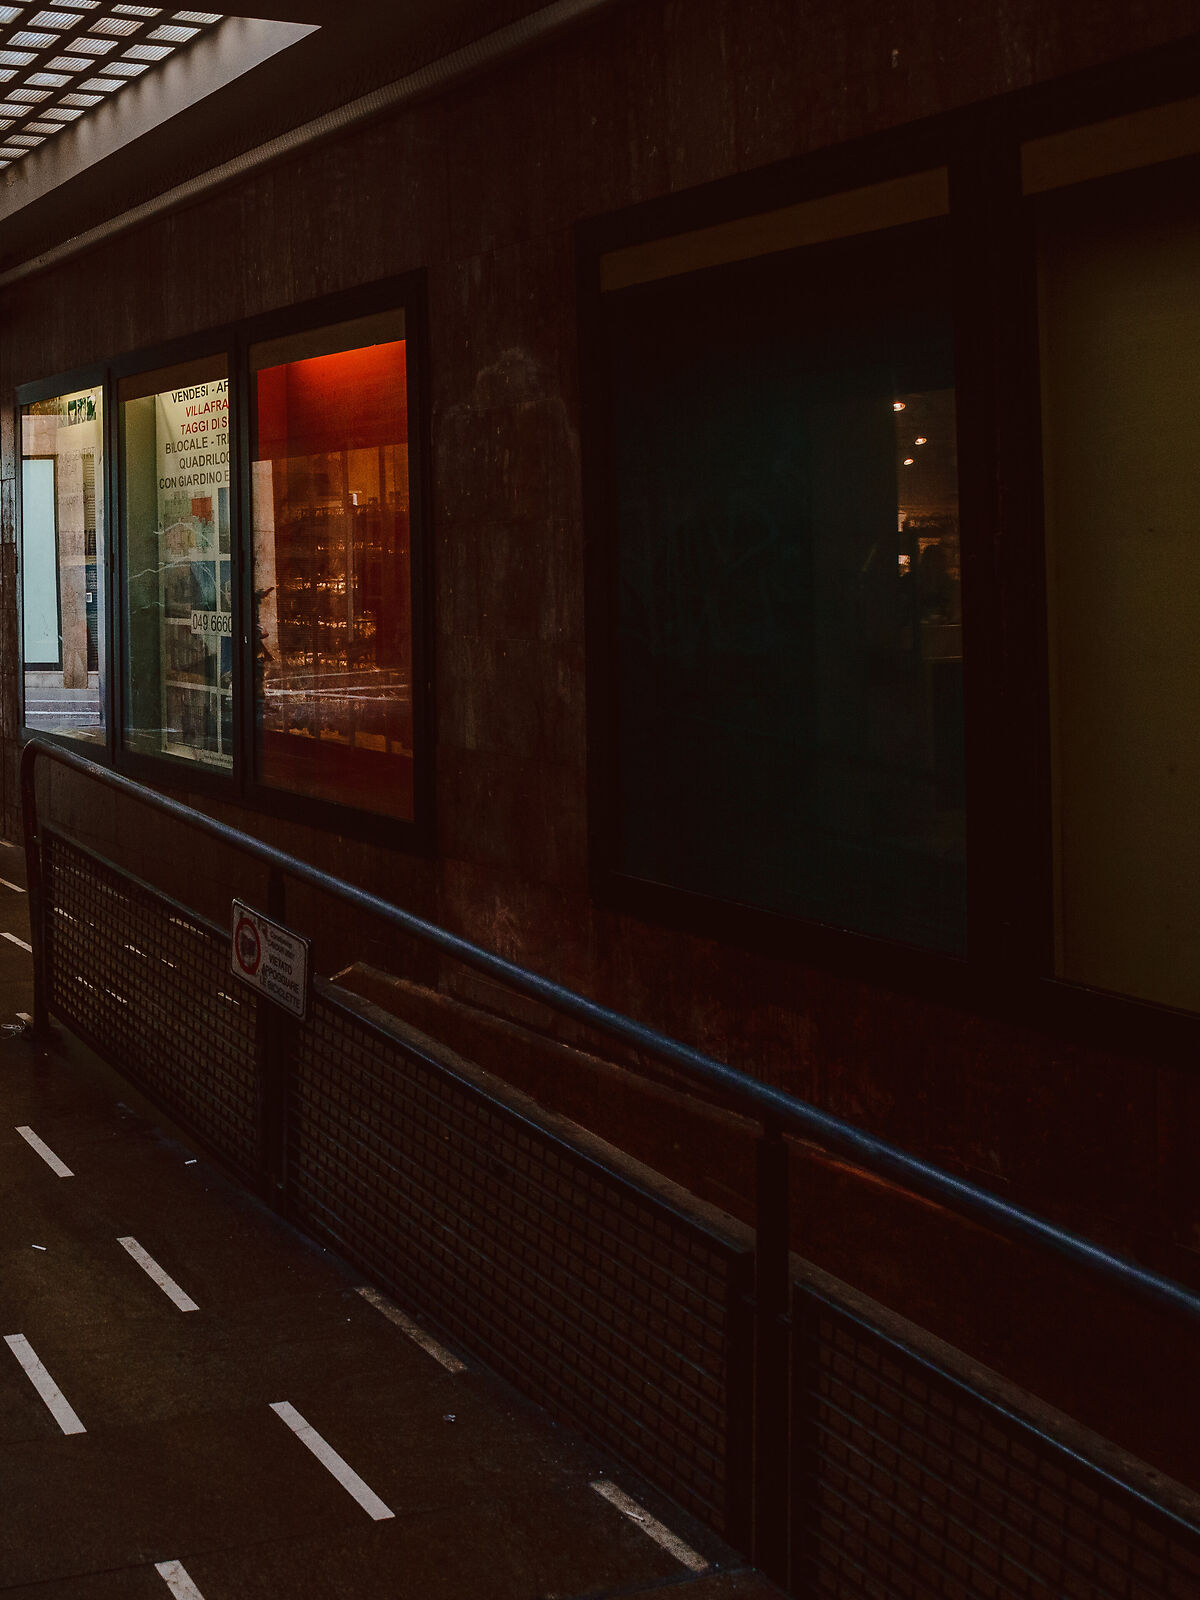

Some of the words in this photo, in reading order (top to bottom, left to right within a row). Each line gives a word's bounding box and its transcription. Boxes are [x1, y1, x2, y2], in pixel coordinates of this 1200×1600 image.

[171, 385, 209, 403] VENDESI
[185, 398, 229, 417] VILLAFRA
[180, 420, 209, 435] TAGGI
[211, 417, 220, 430] DI
[221, 416, 228, 428] S
[165, 436, 208, 455] BILOCALE
[159, 477, 177, 490] CON
[178, 470, 223, 488] GIARDINO
[192, 613, 209, 631] 049
[269, 953, 293, 976] VIETATO
